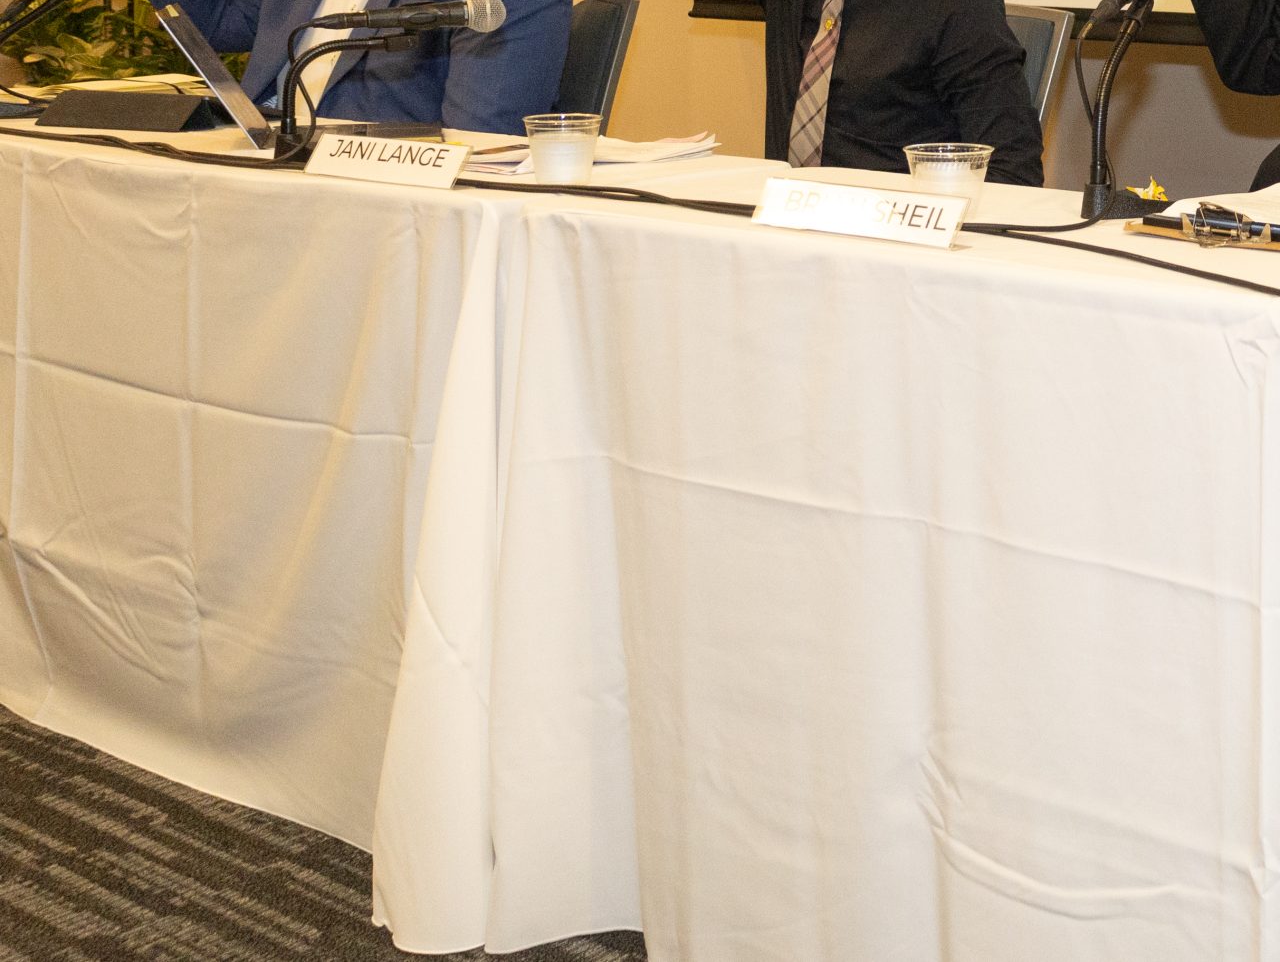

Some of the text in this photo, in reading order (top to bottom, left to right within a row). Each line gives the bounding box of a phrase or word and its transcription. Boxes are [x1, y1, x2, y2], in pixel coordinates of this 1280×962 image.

[329, 139, 450, 168] JANI LANGE
[872, 200, 947, 231] SHEIL
